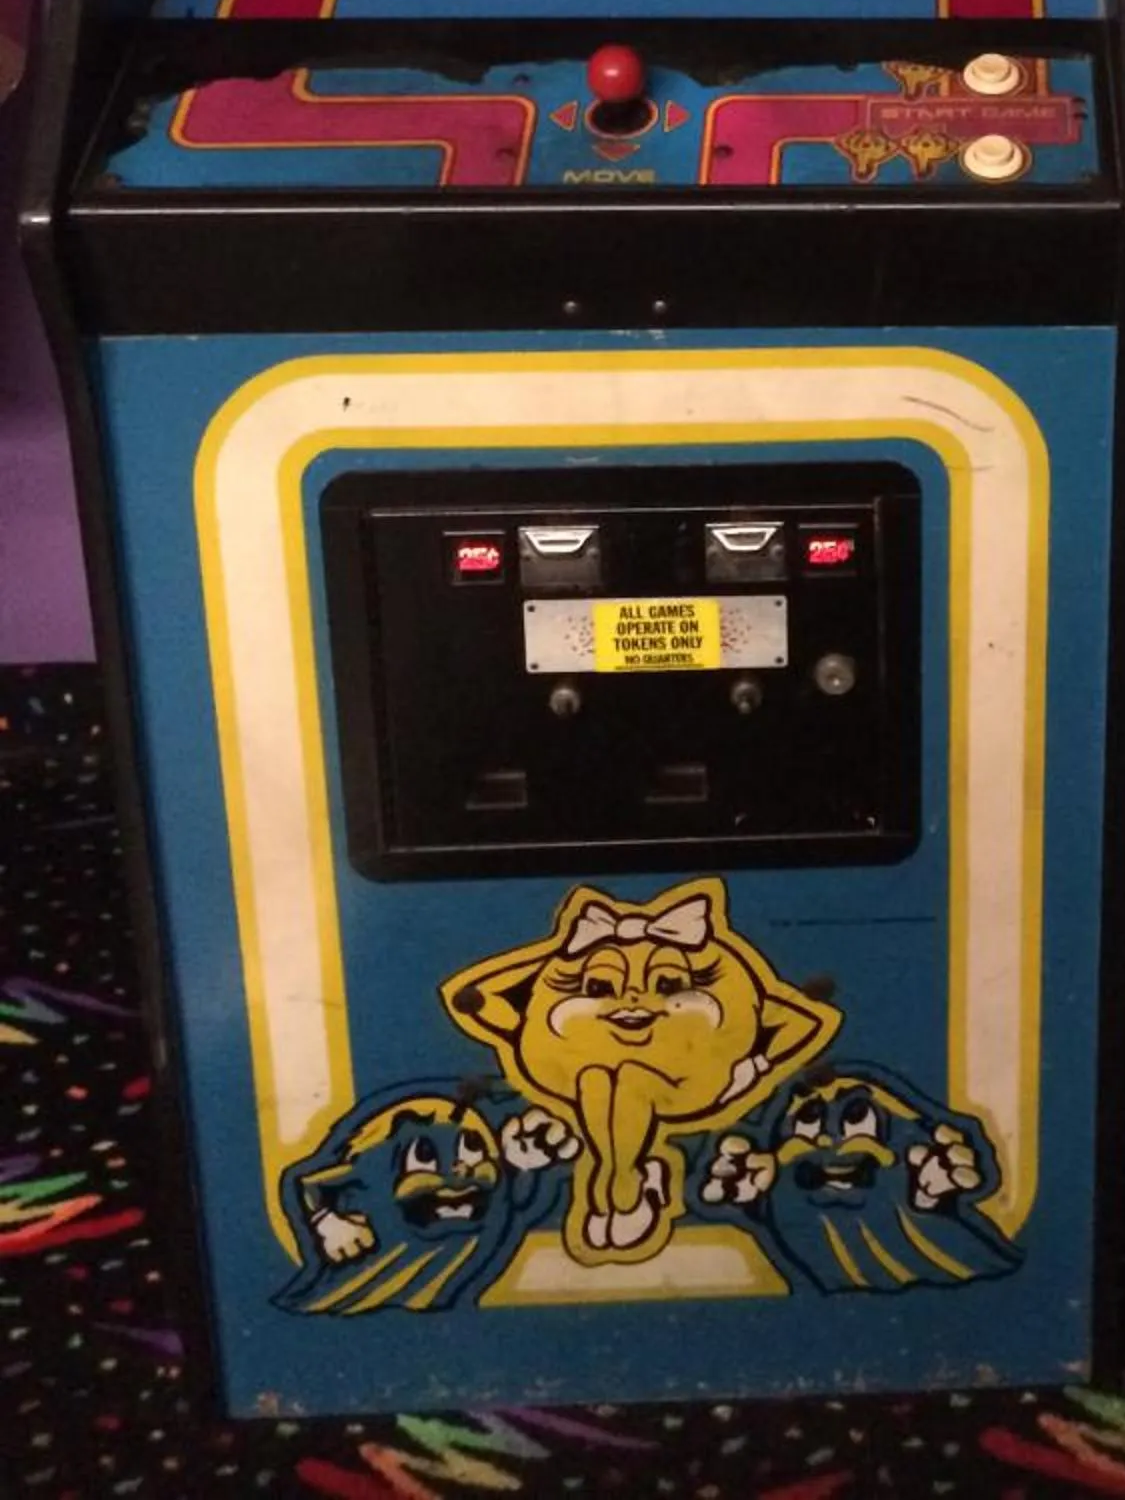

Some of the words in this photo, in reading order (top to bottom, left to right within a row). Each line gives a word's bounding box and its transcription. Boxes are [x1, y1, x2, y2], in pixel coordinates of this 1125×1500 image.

[981, 107, 1057, 120] GAME
[563, 168, 656, 185] MOVE
[619, 605, 644, 618] ALL
[648, 604, 696, 618] GAMES
[616, 620, 675, 635] OPERATE
[680, 619, 700, 633] ON
[614, 637, 667, 652] TOKENS
[671, 635, 703, 649] ONLY
